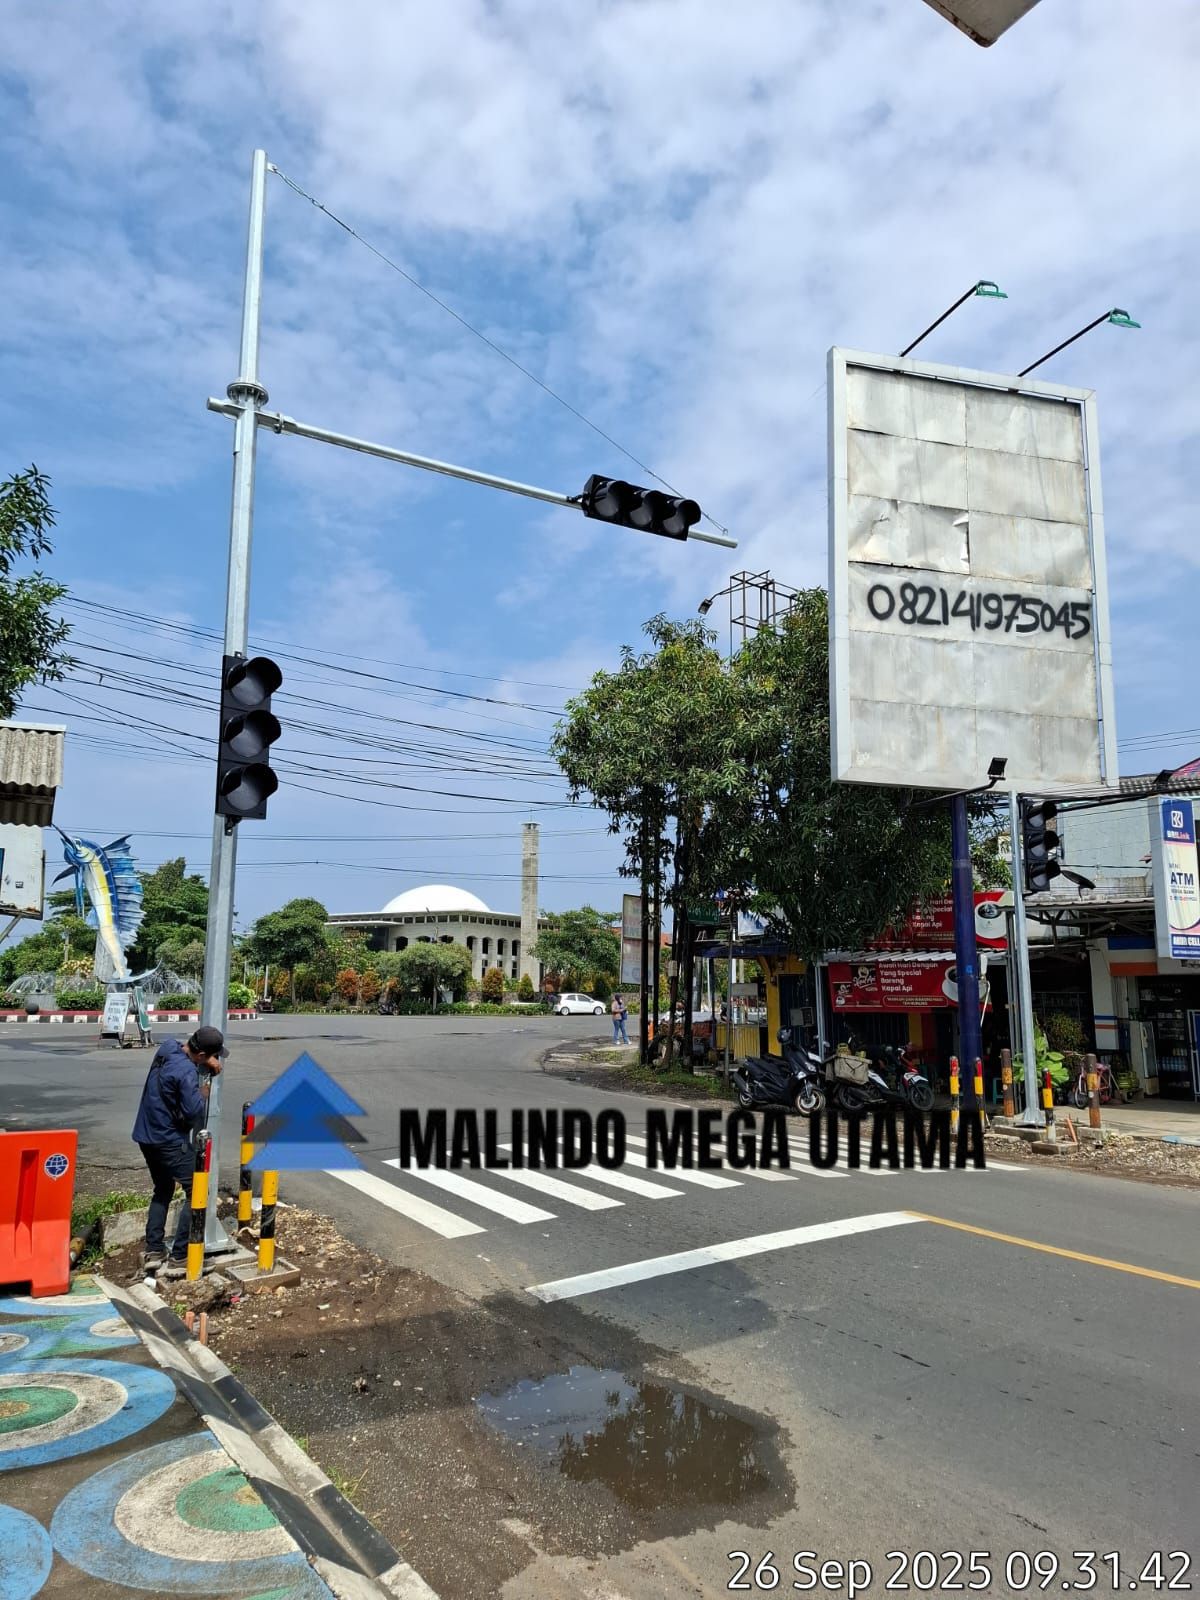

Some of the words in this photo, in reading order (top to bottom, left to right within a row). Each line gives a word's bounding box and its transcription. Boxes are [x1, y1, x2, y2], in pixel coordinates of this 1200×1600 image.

[867, 582, 1091, 640] 082141975045
[1170, 872, 1194, 886] ATM
[880, 970, 897, 978] Yang
[898, 969, 922, 977] Special
[881, 977, 904, 985] Bareng
[901, 985, 913, 993] Api
